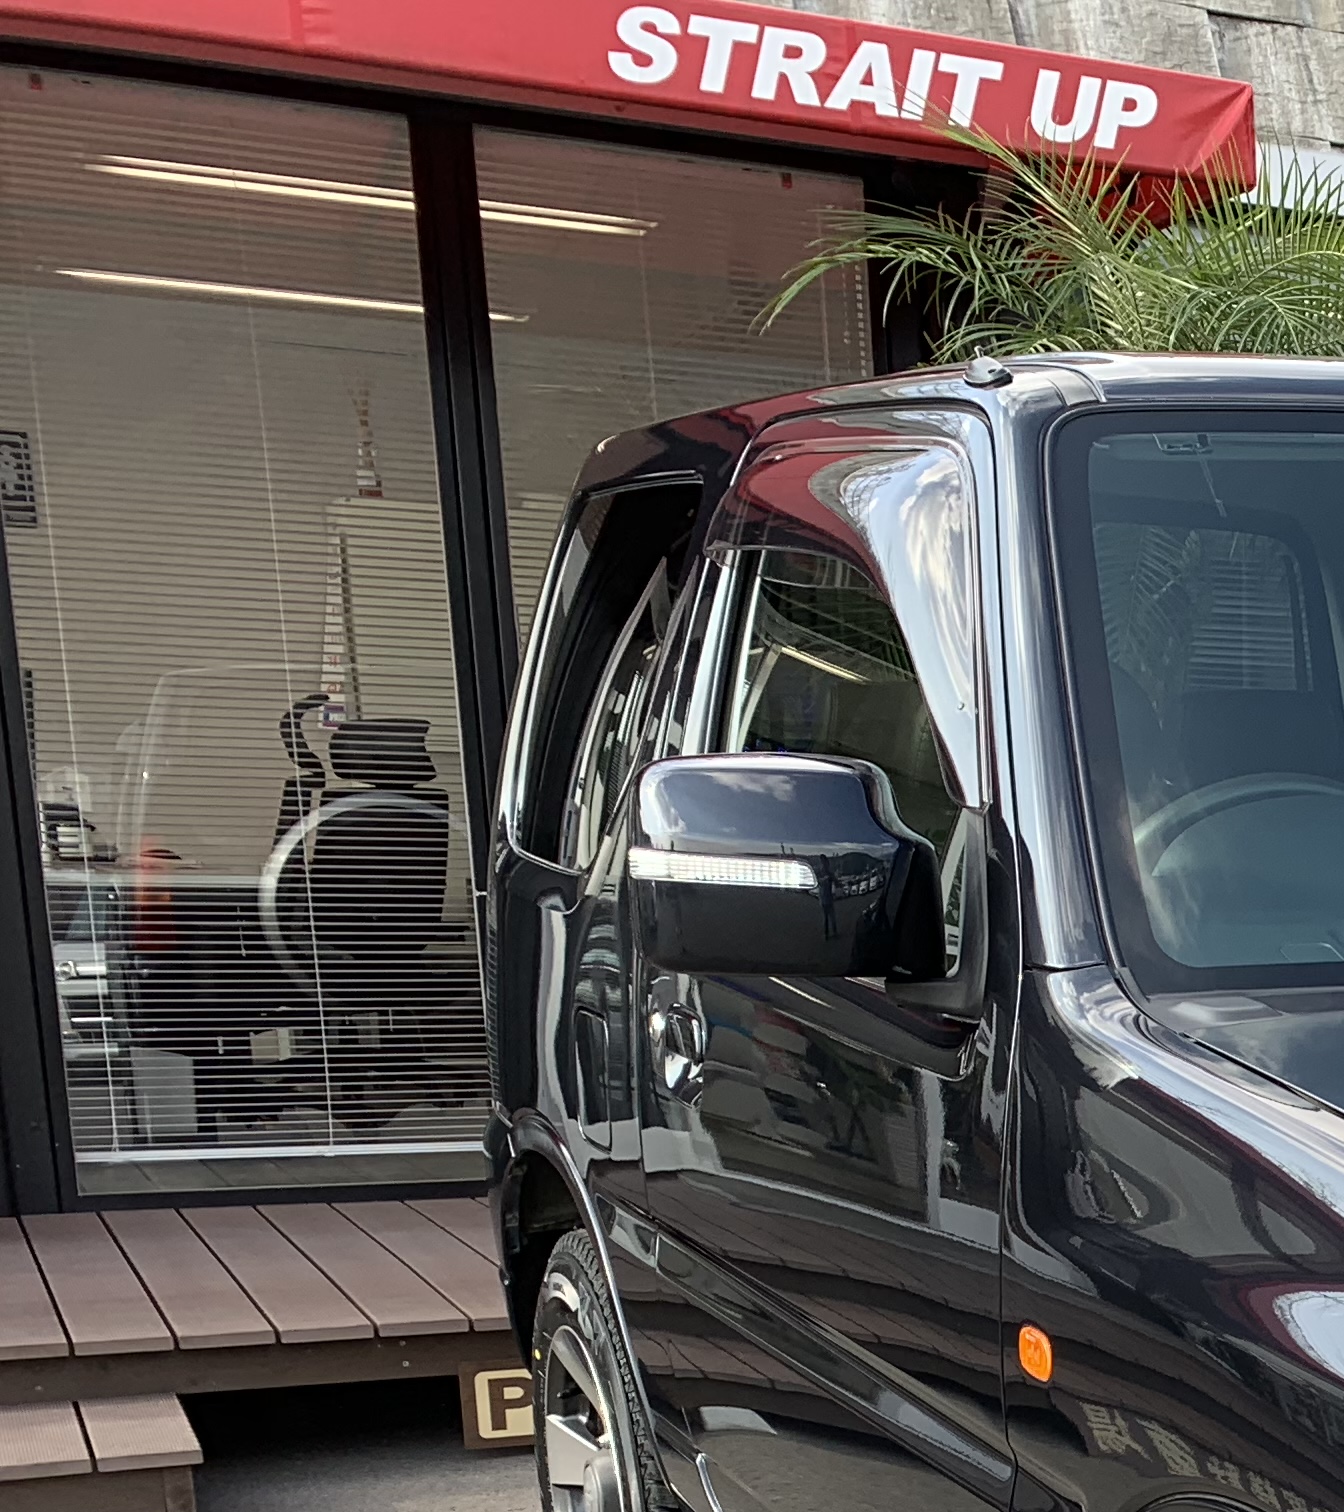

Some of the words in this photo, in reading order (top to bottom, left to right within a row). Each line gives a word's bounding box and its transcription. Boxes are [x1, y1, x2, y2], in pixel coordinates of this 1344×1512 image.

[607, 5, 1004, 129] STRAIT
[1029, 69, 1158, 150] UP
[488, 1377, 535, 1432] P
